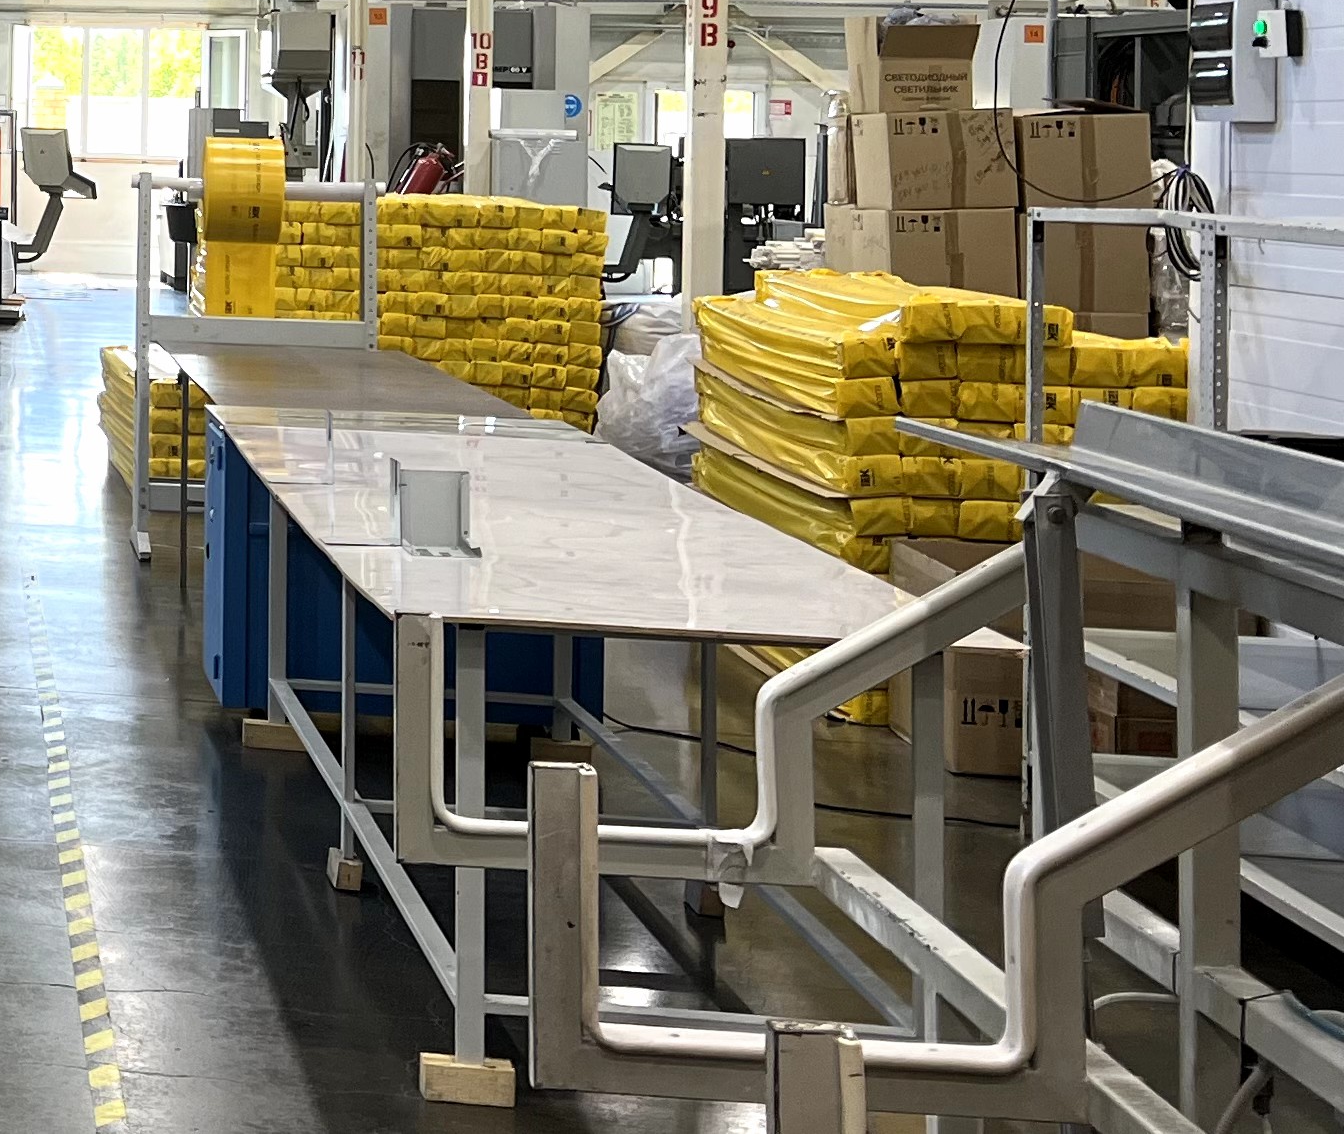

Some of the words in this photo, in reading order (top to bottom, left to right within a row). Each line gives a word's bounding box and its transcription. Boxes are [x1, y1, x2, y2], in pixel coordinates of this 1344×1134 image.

[471, 33, 491, 49] 10
[884, 72, 968, 82] СВЕТОДИОДНЫЙ
[893, 85, 958, 94] СВЕТИЛЬНИК
